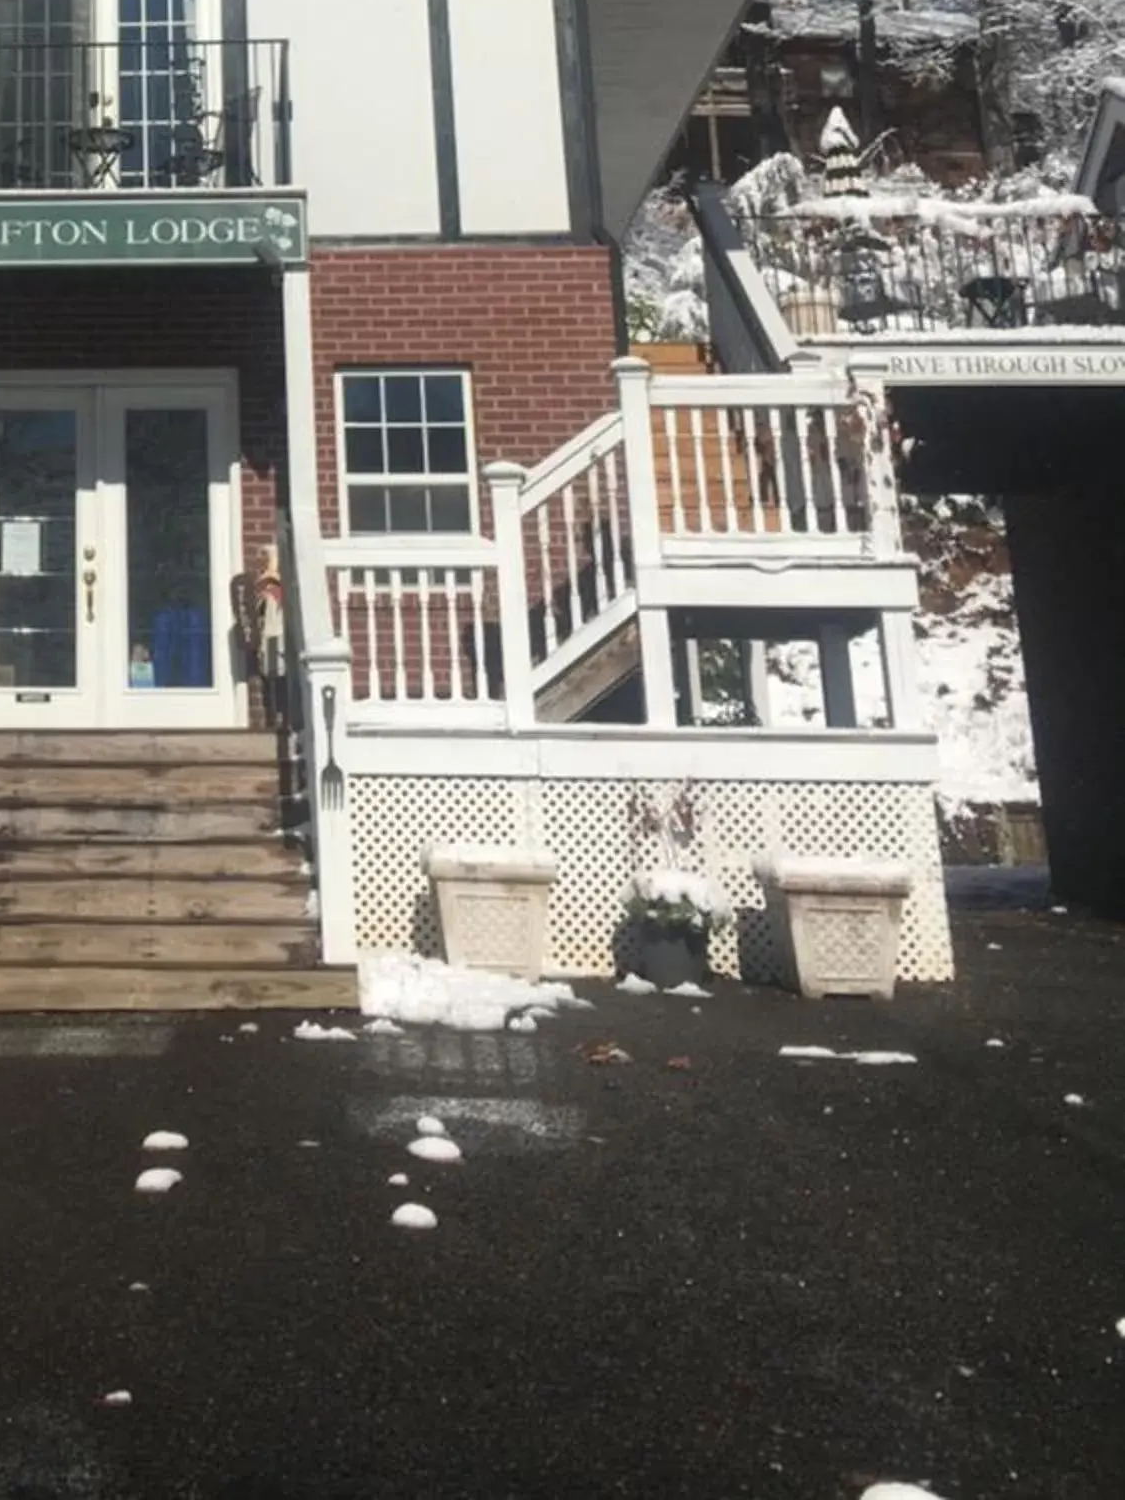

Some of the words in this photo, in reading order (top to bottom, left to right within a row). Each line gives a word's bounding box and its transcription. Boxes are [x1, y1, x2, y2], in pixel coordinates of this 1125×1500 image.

[126, 217, 264, 245] LODGE
[890, 355, 946, 374] RIVE
[948, 355, 1067, 375] THROUGH
